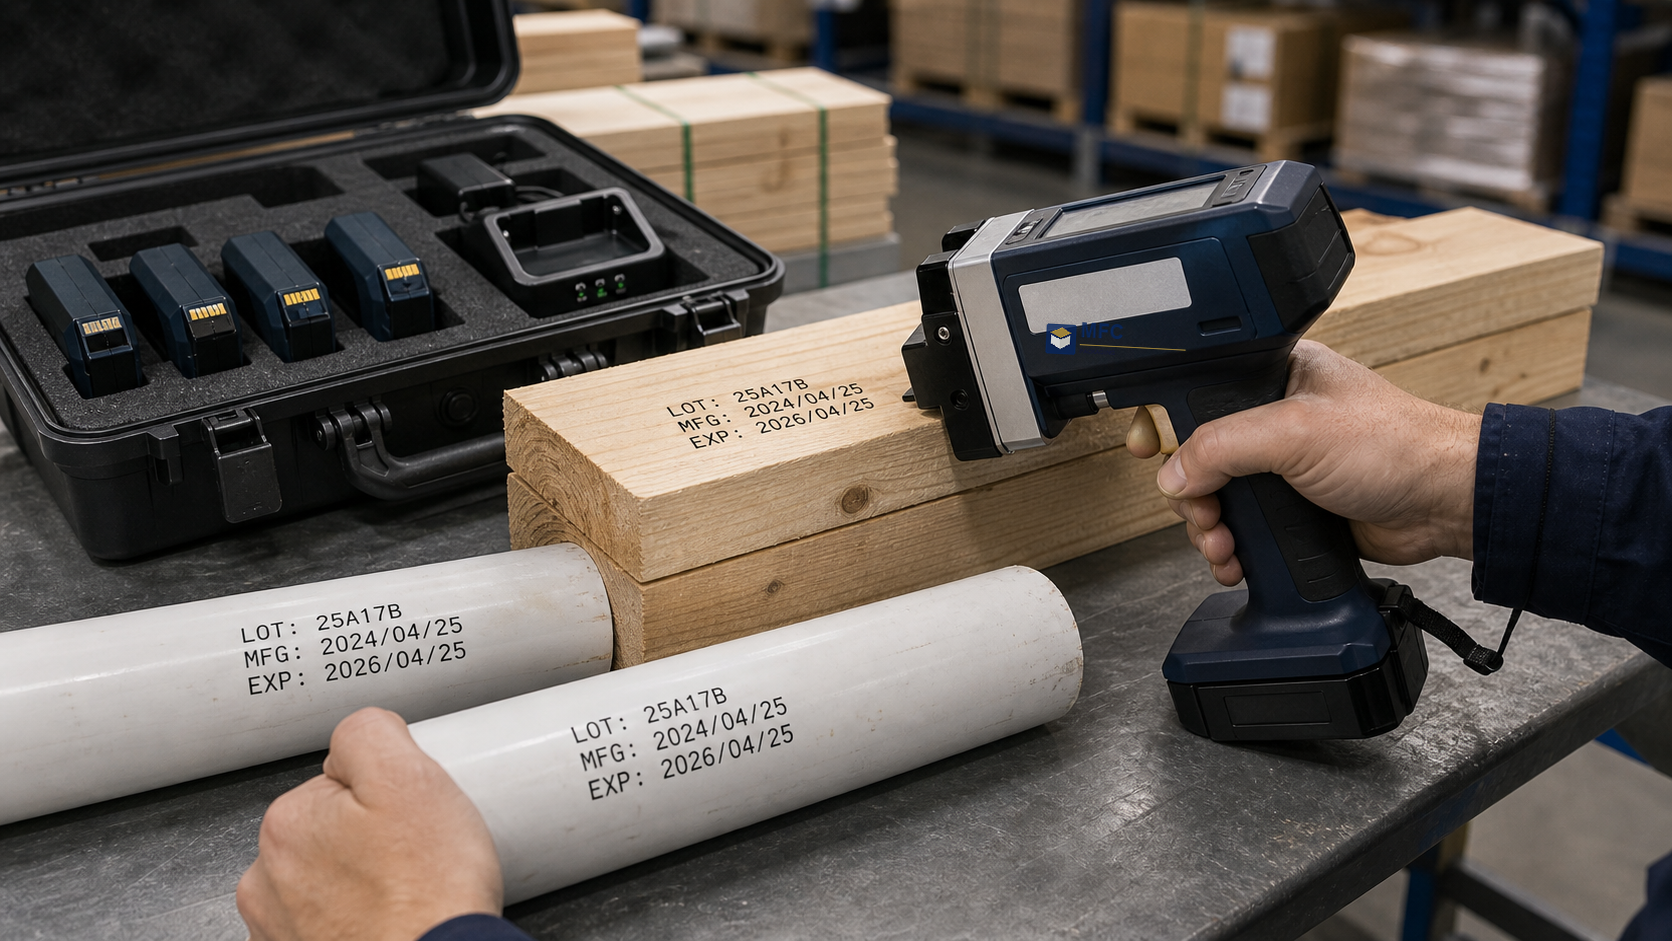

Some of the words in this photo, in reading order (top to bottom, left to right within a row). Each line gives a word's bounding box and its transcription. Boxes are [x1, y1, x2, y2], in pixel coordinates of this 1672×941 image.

[666, 398, 720, 418] LOT:
[732, 378, 809, 404] 25A17B
[677, 413, 732, 433] MFG:
[743, 382, 864, 419] 2024/04/25
[688, 429, 743, 450] EXP:
[755, 397, 875, 435] 2026/04/25
[240, 621, 297, 644] LOT:
[315, 603, 403, 632] 25A17B
[243, 645, 301, 669] MFG:
[320, 615, 463, 656] 2024/04/25
[247, 670, 305, 696] EXP:
[324, 640, 467, 682] 2026/04/25
[570, 716, 628, 744] LOT:
[643, 686, 728, 724] 25A17B
[579, 742, 637, 772] MFG:
[652, 696, 788, 752] 2024/04/25
[587, 770, 644, 801] EXP:
[660, 723, 794, 780] 2026/04/25
